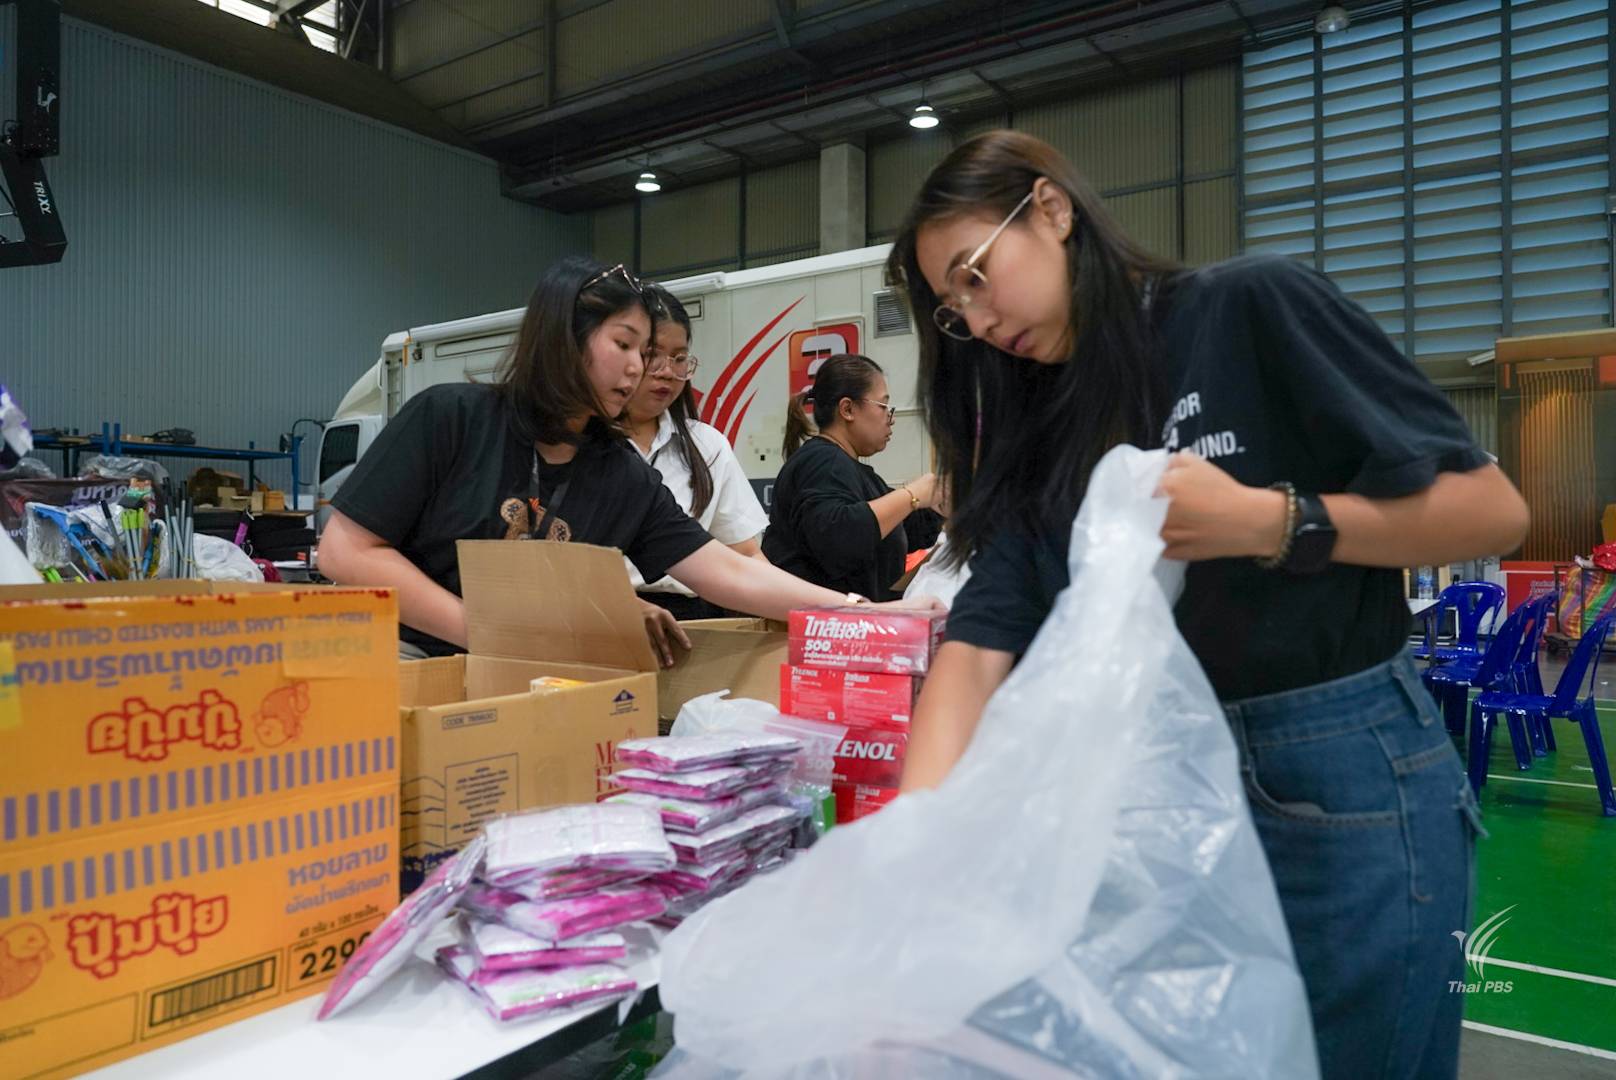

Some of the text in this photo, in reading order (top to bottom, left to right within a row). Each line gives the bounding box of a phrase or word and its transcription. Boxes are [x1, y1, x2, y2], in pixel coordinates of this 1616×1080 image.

[117, 623, 195, 643] ROASTED
[200, 620, 240, 636] WITH
[244, 615, 290, 634] LAMS
[3, 631, 51, 650] PAS
[57, 626, 113, 648] CHILLI
[804, 639, 832, 652] 500
[66, 891, 229, 981] ปุ้มปุ้ย
